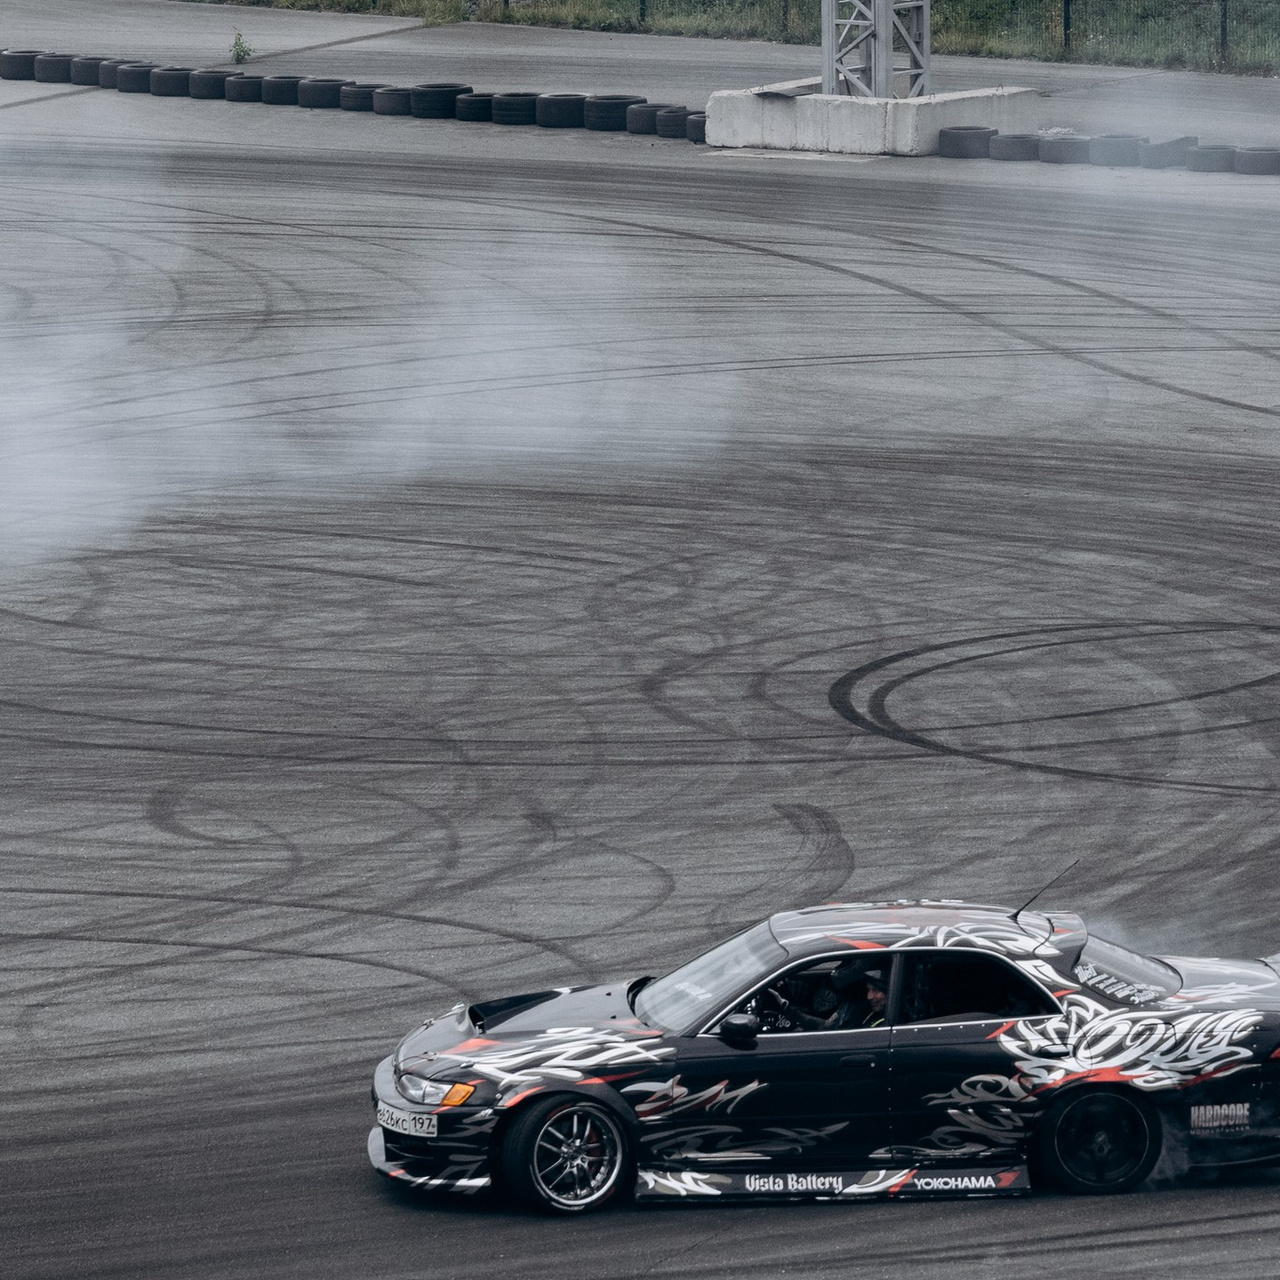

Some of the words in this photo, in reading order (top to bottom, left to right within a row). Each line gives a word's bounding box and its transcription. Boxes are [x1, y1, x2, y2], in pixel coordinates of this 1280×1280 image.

[411, 1116, 432, 1130] 197
[1191, 1103, 1250, 1128] HARDCORE
[745, 1174, 784, 1191] Vista
[787, 1173, 843, 1194] Battery
[914, 1175, 996, 1190] YOKOHAMA
